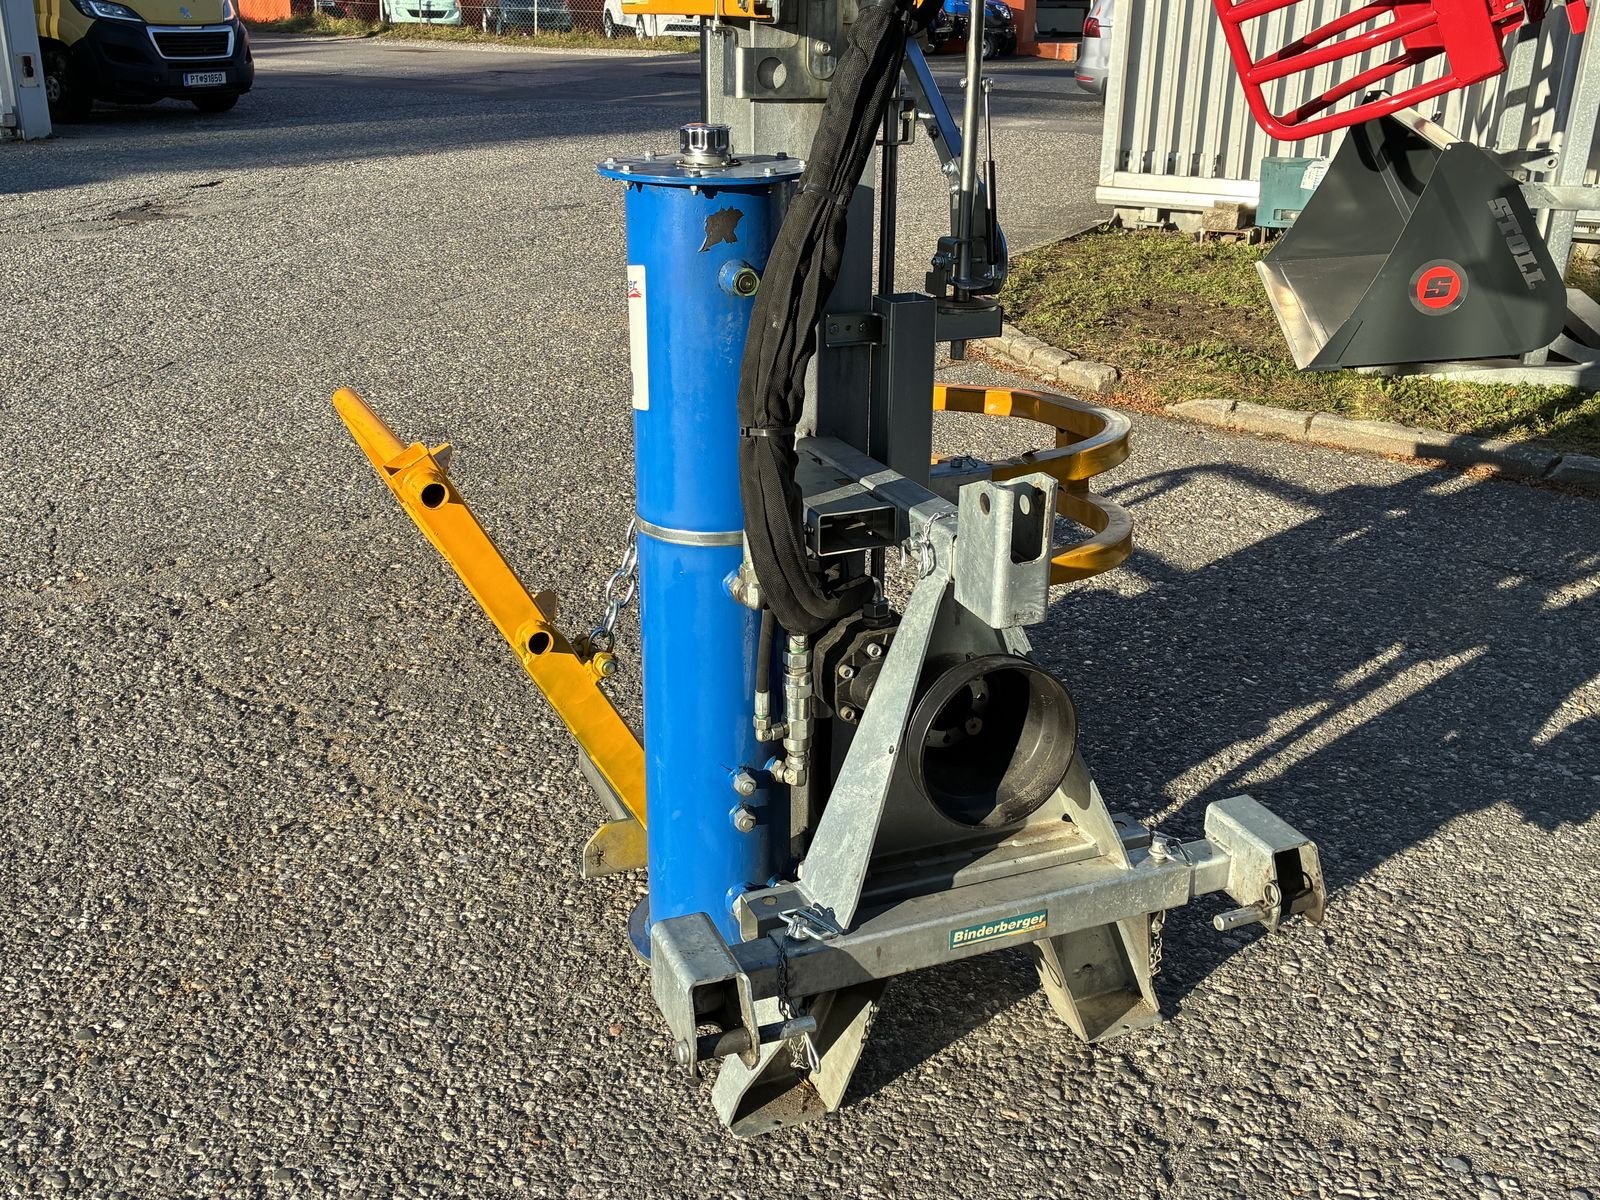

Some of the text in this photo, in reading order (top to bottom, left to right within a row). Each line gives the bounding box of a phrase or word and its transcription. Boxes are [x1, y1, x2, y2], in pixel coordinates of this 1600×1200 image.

[190, 74, 199, 84] PT
[1487, 197, 1546, 290] STOLL
[953, 913, 1046, 943] Binderberger
